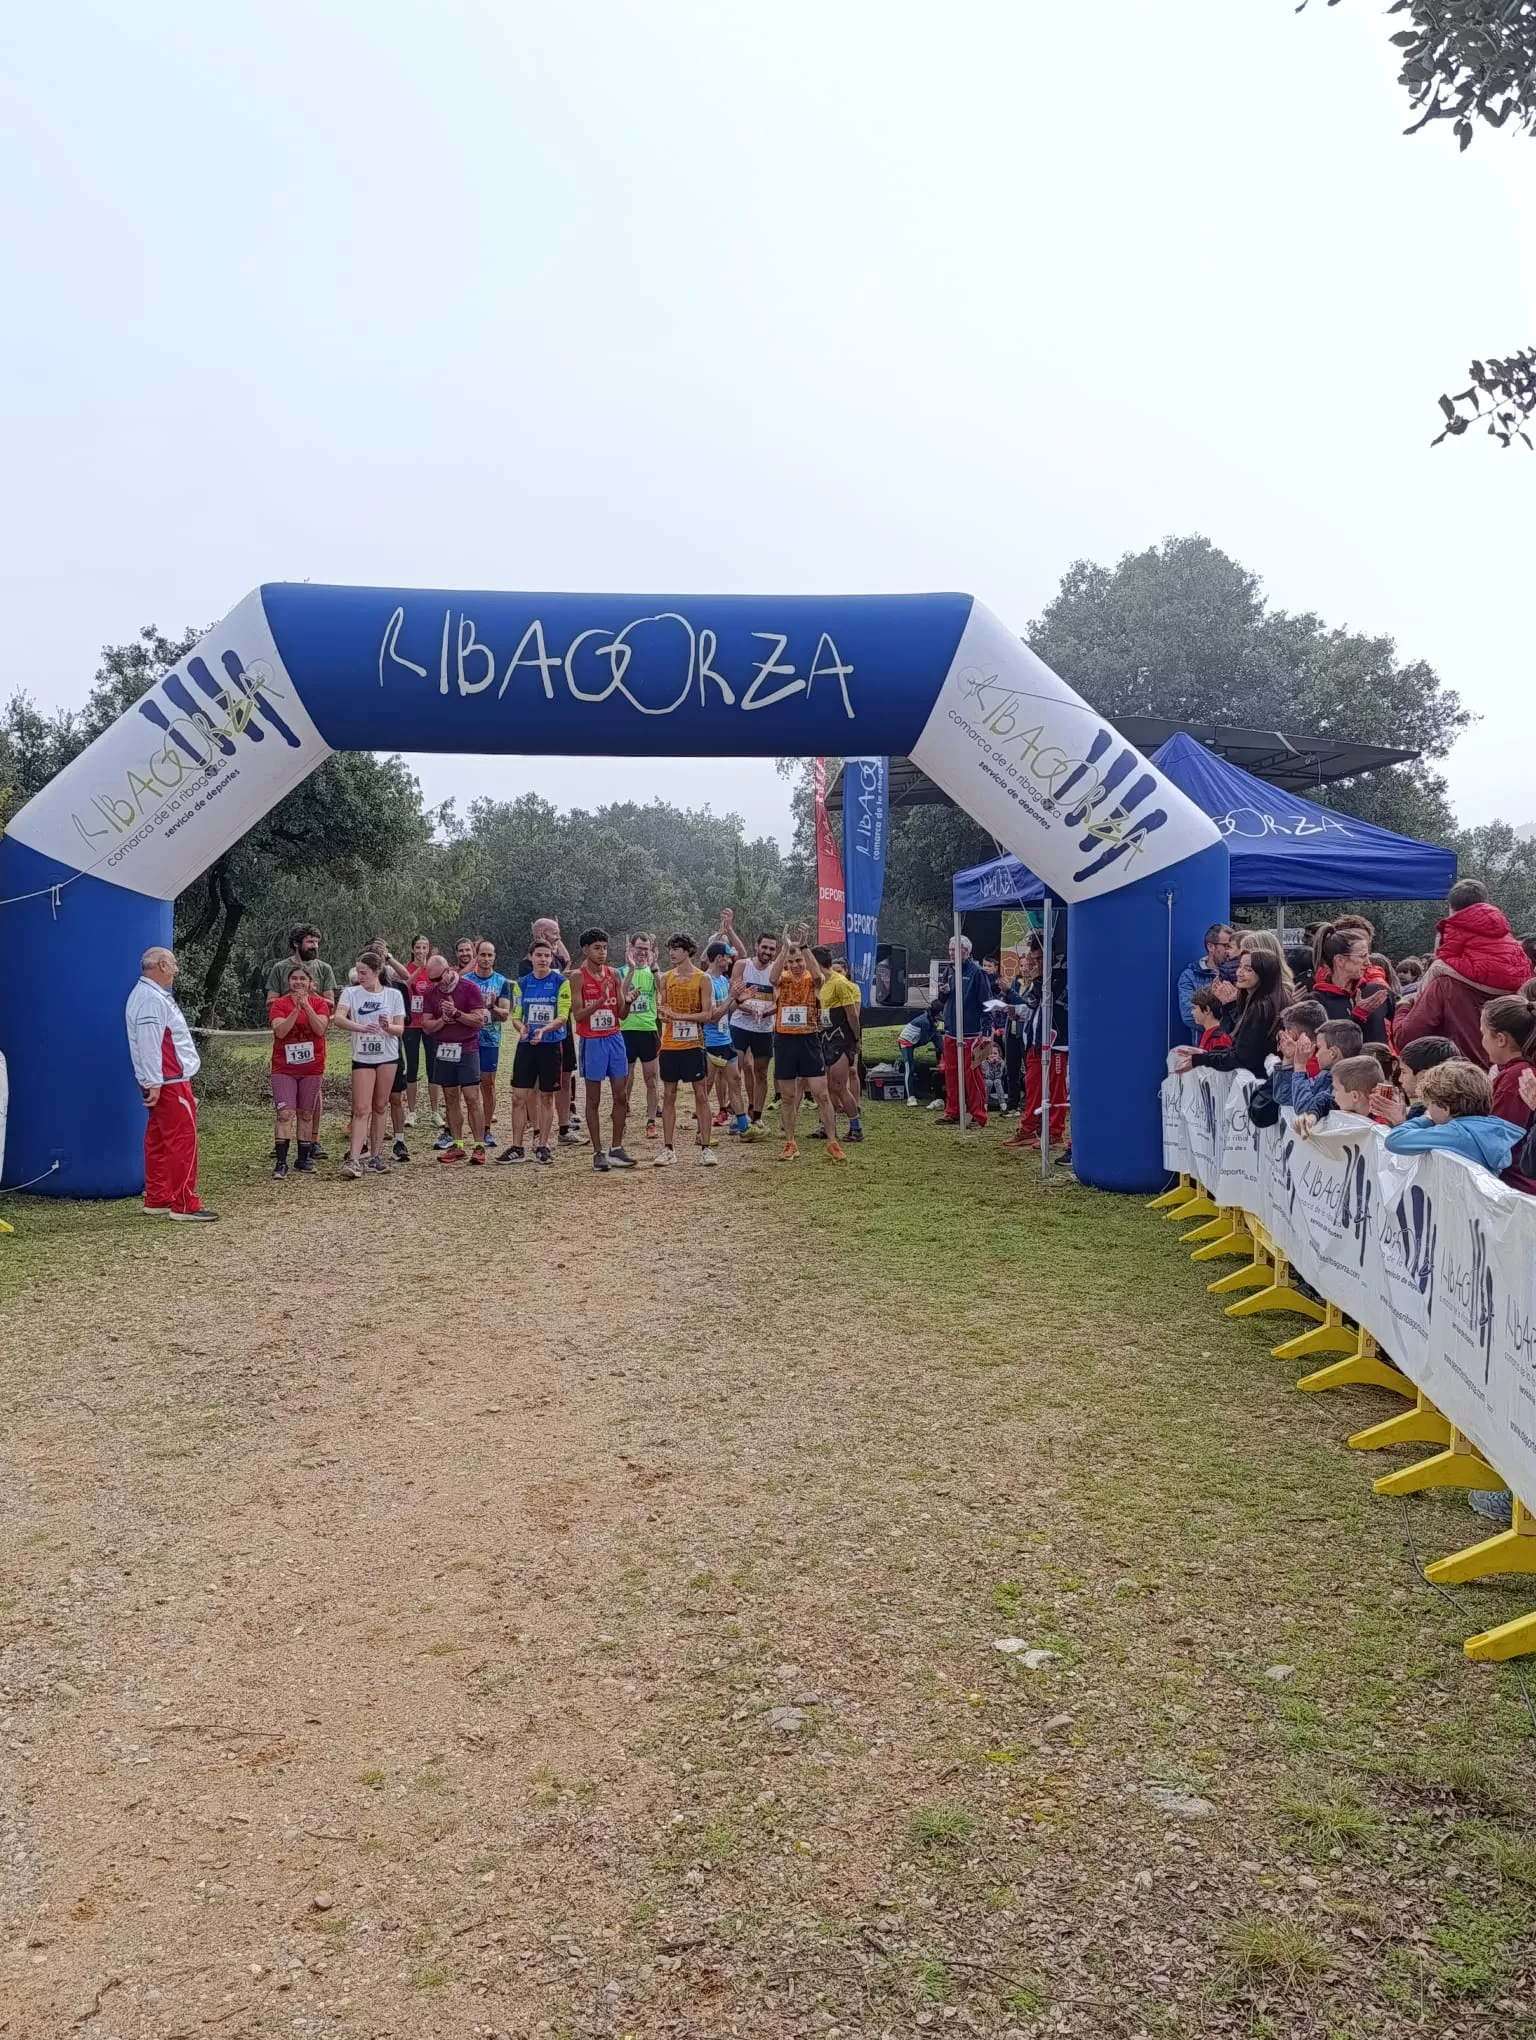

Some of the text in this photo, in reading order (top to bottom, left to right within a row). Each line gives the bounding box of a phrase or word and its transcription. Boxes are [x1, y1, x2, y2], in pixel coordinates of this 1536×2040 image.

[379, 605, 856, 719] RIBAGORZA
[948, 709, 1062, 819] comarca de la ribagoza
[978, 760, 1052, 831] servicio de deportes
[164, 768, 241, 838] servicio de deportes
[107, 757, 227, 867] comarca de la ribagoza
[362, 1001, 382, 1009] NIKE
[631, 1002, 648, 1010] 146
[532, 1012, 550, 1021] 166
[787, 1013, 801, 1023] 48
[594, 1017, 613, 1027] 139
[678, 1028, 691, 1037] 77
[361, 1042, 382, 1052] 108
[290, 1050, 311, 1061] 130
[440, 1048, 457, 1058] 171
